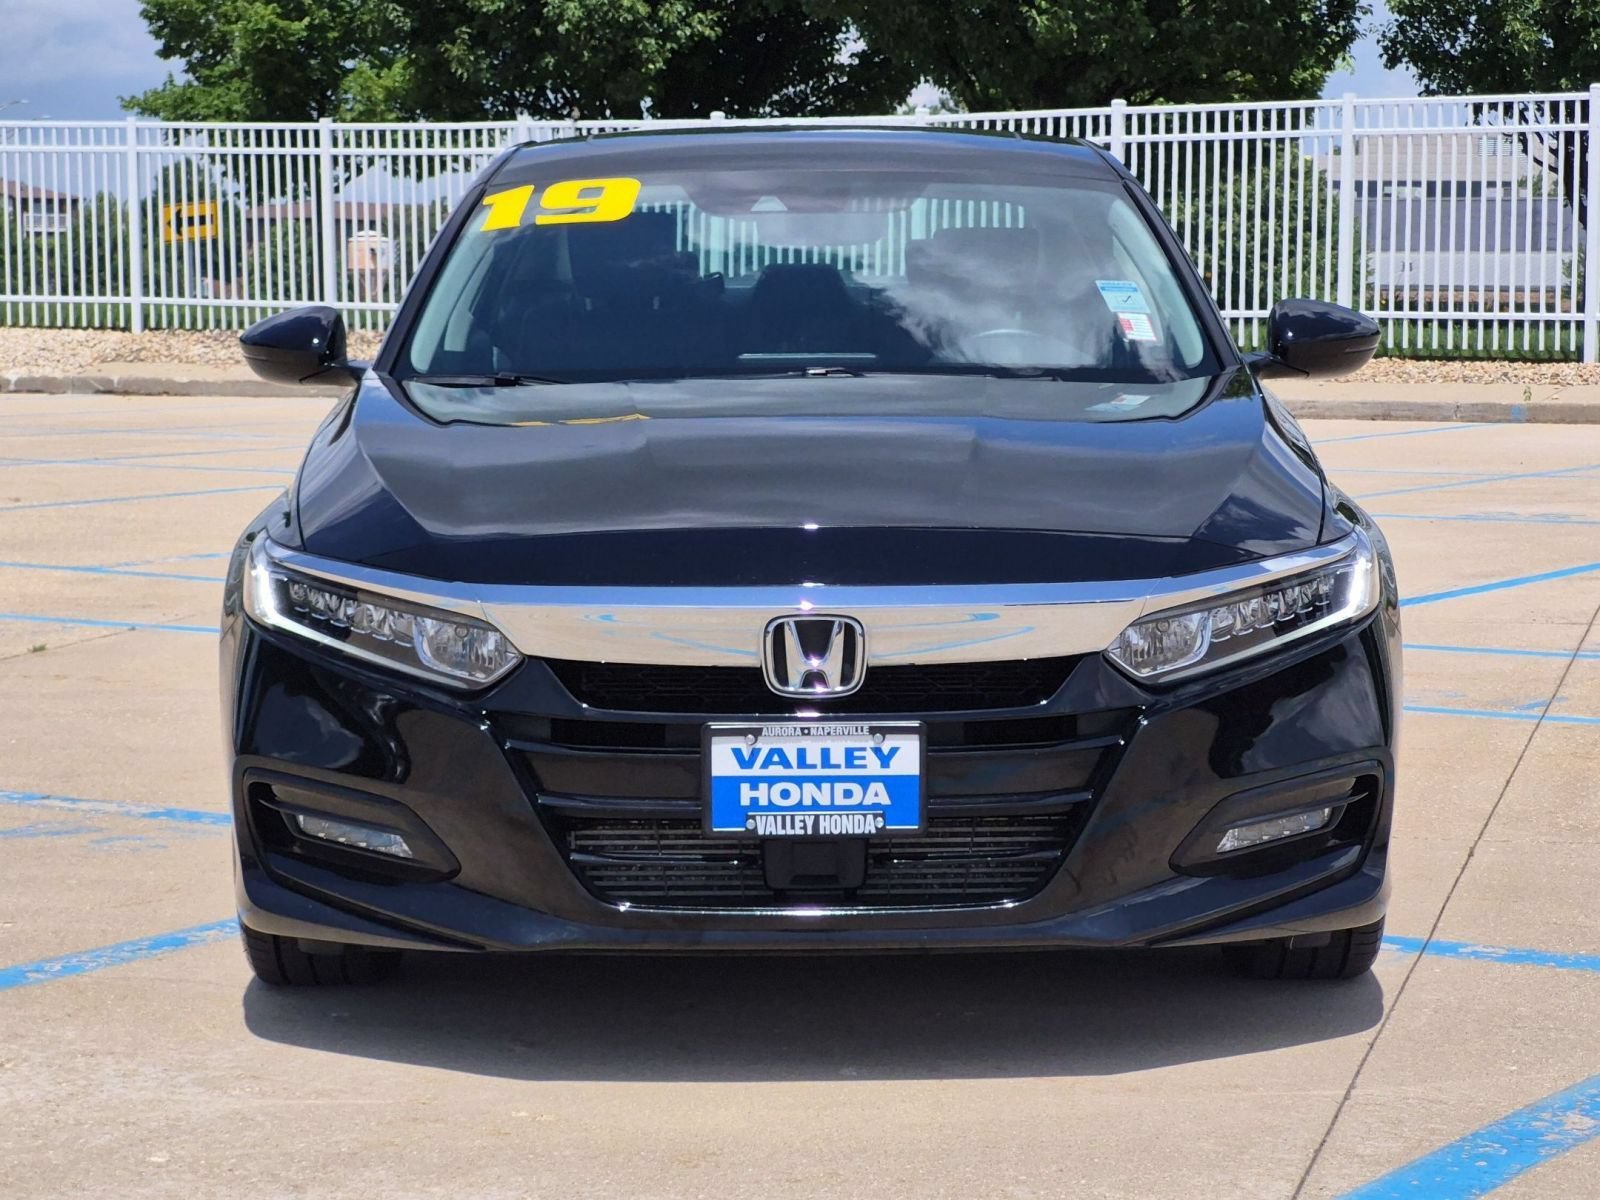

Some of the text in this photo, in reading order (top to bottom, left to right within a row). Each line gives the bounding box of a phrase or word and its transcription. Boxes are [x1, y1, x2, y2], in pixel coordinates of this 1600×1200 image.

[480, 177, 641, 231] 19
[762, 726, 869, 737] AURORA NAPERVILLE
[731, 747, 900, 769] VALLEY
[740, 782, 891, 806] HONDA
[756, 814, 876, 835] VALLEY HONDA
